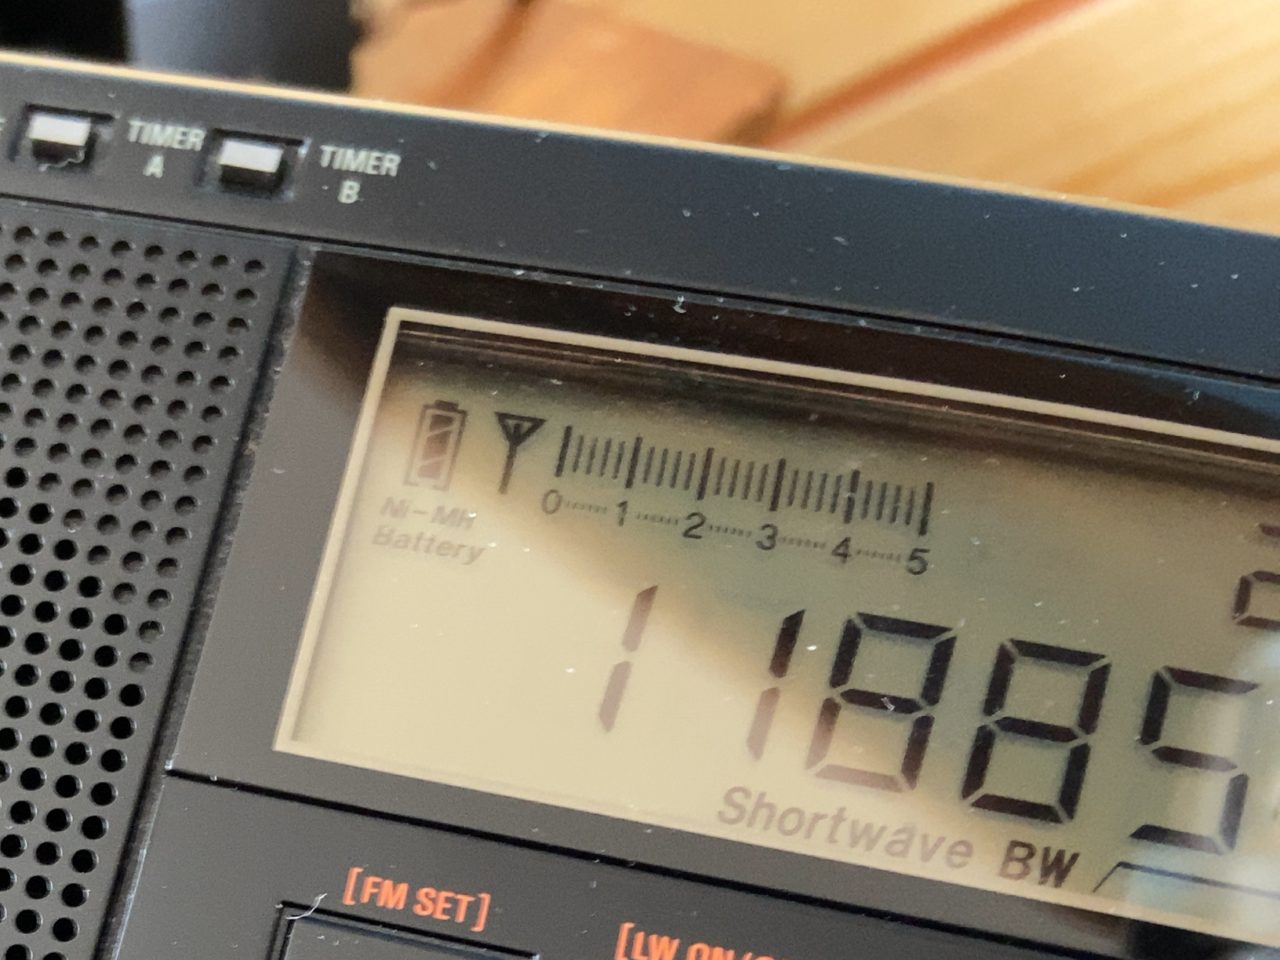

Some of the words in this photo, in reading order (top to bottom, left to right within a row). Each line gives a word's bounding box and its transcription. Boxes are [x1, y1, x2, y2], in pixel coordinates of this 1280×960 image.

[127, 119, 207, 151] TIMER
[143, 155, 165, 178] A
[320, 144, 401, 177] TIMER
[337, 180, 360, 204] B
[617, 500, 629, 527] 1
[682, 512, 708, 540] 2
[754, 523, 779, 551] 3
[830, 536, 853, 564] 4
[905, 547, 931, 576] 5
[716, 784, 975, 870] Shortwave
[997, 838, 1081, 890] BW
[342, 866, 408, 913] [FM
[413, 882, 491, 932] SET]
